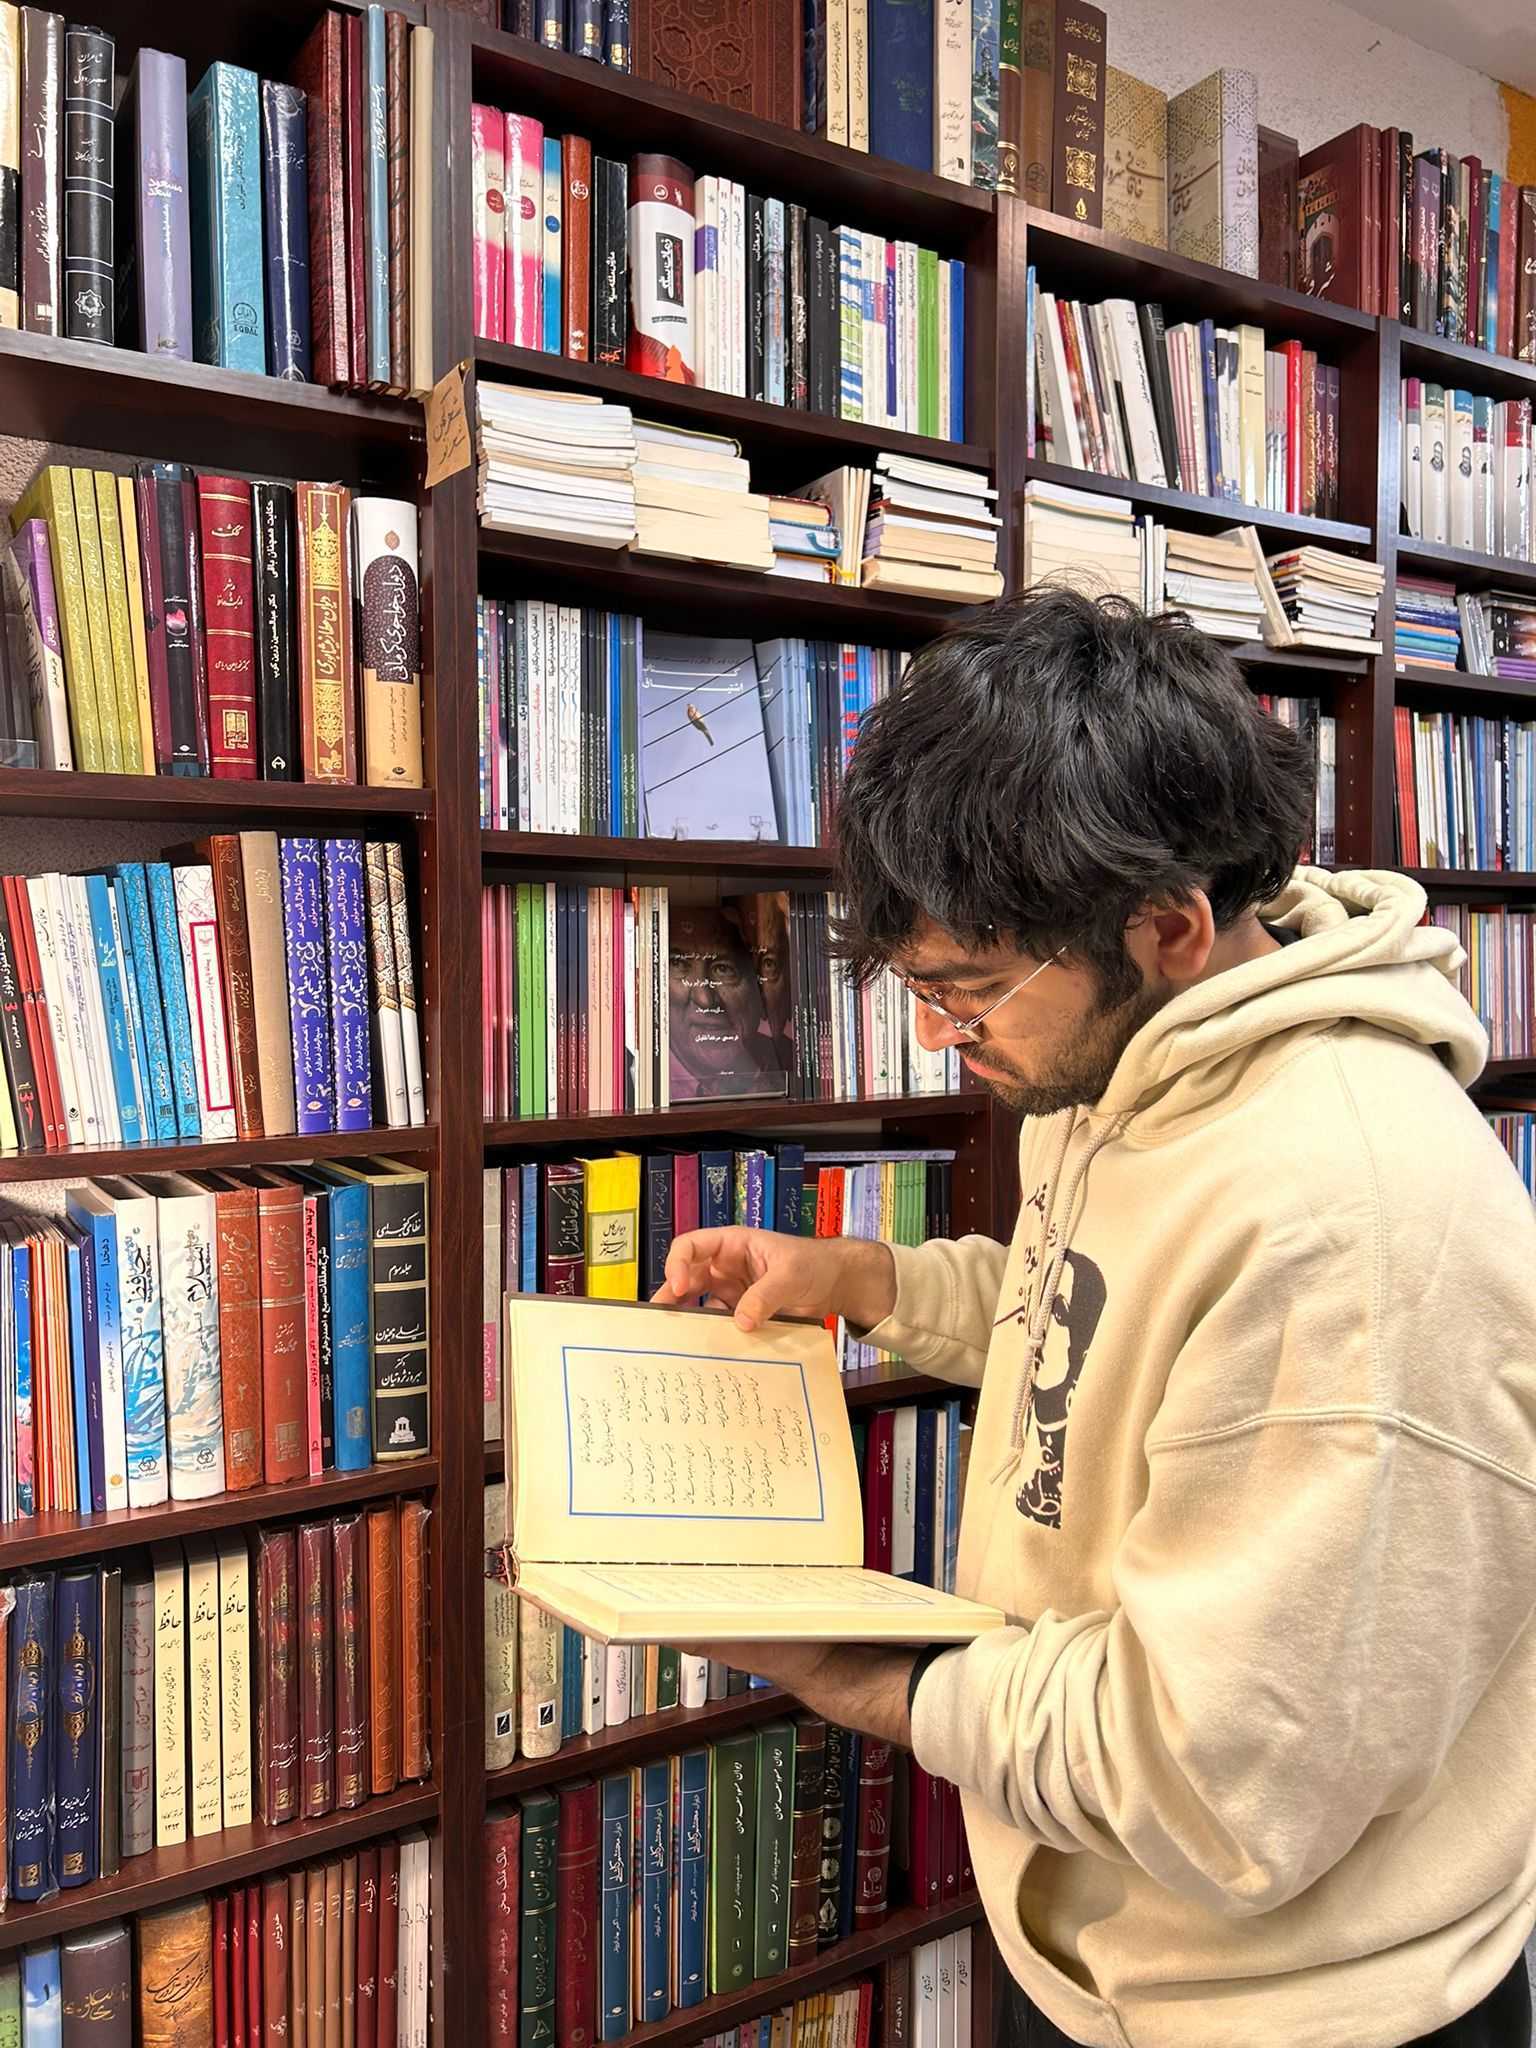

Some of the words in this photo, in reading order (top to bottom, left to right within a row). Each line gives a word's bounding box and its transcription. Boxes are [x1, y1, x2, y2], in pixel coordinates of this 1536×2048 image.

[753, 210, 763, 236] حریر
[752, 231, 762, 262] مهتاب
[234, 324, 259, 336] EQBAL
[266, 500, 276, 526] حکایت
[266, 528, 278, 558] همچنان
[267, 560, 278, 578] باقی
[382, 564, 405, 603] دیوان
[268, 593, 277, 608] دکتر
[314, 595, 337, 621] دیوان
[269, 609, 278, 641] عبدالحسین
[382, 597, 407, 644] خواجوی
[271, 644, 279, 662] زرین
[315, 638, 340, 675] نیشابوری
[379, 637, 408, 680] کرمانی
[270, 662, 280, 678] کوب
[519, 706, 527, 721] مرگ
[293, 868, 304, 886] مولانا
[336, 868, 346, 886] مولانا
[308, 878, 317, 901] مشهور
[350, 878, 358, 900] مشهور
[308, 908, 318, 928] مولوی
[350, 907, 360, 927] مولوی
[297, 921, 306, 938] محمد
[339, 921, 348, 937] محمد
[3, 975, 15, 997] مولوی
[301, 1029, 309, 1057] تصحیحات
[342, 1026, 351, 1054] تصحیحات
[302, 1061, 313, 1077] حواشی
[314, 1052, 324, 1073] فروزانفر
[344, 1058, 353, 1075] حواشی
[355, 1050, 364, 1071] فروزانفر
[751, 1175, 762, 1190] دیوان
[652, 1202, 670, 1221] منظوم
[751, 1188, 762, 1216] رباعیات
[304, 1207, 315, 1225] گزیده
[305, 1227, 315, 1245] مخزن
[402, 1218, 421, 1236] نظامی
[603, 1219, 618, 1237] کامل
[613, 1225, 627, 1237] دیوان
[100, 1238, 112, 1267] دهخدا
[305, 1247, 316, 1269] الاسرار
[318, 1247, 329, 1260] شرح
[126, 1248, 147, 1304] حافظ
[317, 1259, 329, 1295] معلقات
[388, 1265, 402, 1282] سوم
[400, 1263, 412, 1275] جلد
[104, 1291, 112, 1302] سحر
[319, 1294, 331, 1313] سبع
[320, 1319, 329, 1333] احمد
[375, 1327, 394, 1342] مجنون
[394, 1353, 410, 1369] دکتر
[310, 1370, 318, 1387] ثروتیان
[381, 1368, 407, 1387] ثروتیان
[404, 1370, 423, 1384] بهروز
[193, 1601, 217, 1624] حافظ
[223, 1593, 246, 1616] حافظ
[157, 1609, 182, 1632] حافظ
[772, 1748, 784, 1767] دیوان
[733, 1761, 744, 1781] دیوان
[773, 1768, 783, 1783] مسعود
[734, 1782, 744, 1797] مسعود
[774, 1782, 783, 1804] سعد
[691, 1794, 701, 1810] دیوان
[734, 1796, 744, 1818] سعد
[60, 1812, 80, 1829] شیرازی
[79, 1811, 90, 1824] حافظ
[654, 1808, 664, 1824] دیوان
[692, 1809, 700, 1833] محتشم
[774, 1803, 784, 1821] سلمان
[16, 1823, 35, 1840] شیرازی
[34, 1823, 45, 1836] حافظ
[613, 1822, 623, 1838] دیوان
[735, 1817, 745, 1835] سلمان
[655, 1824, 663, 1848] محتشم
[687, 1831, 703, 1854] کاشانی
[495, 1846, 508, 1869] مالک
[614, 1838, 622, 1862] محتشم
[649, 1846, 665, 1868] کاشانی
[608, 1860, 625, 1883] کاشانی
[498, 1892, 511, 1915] سخن
